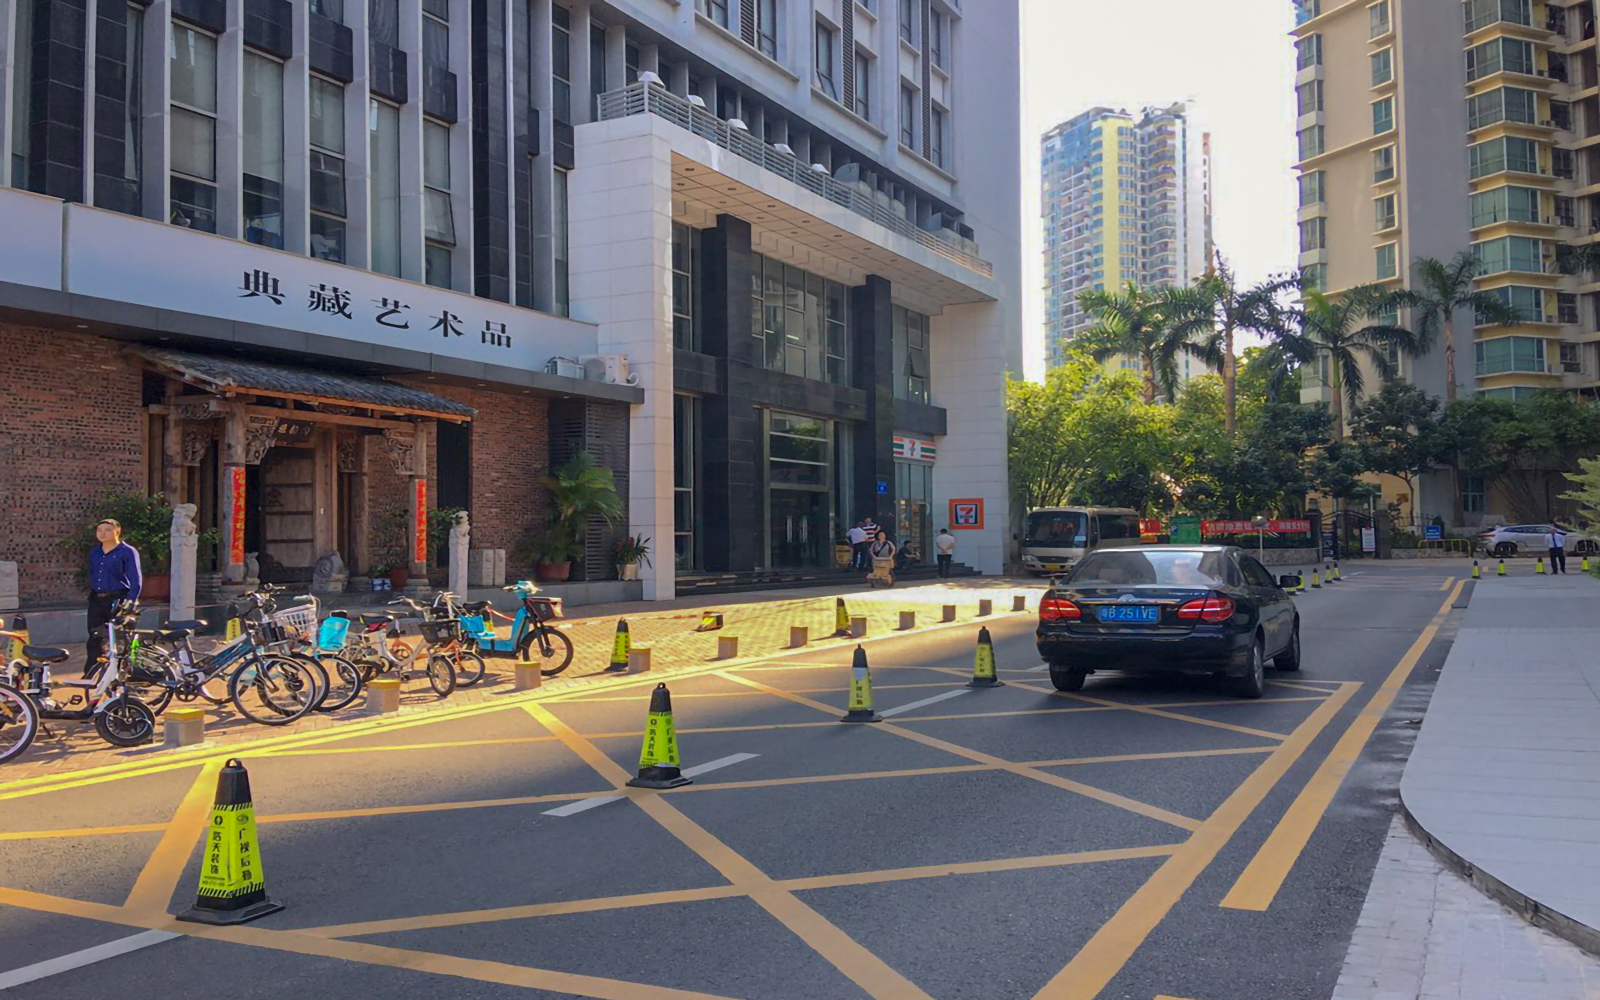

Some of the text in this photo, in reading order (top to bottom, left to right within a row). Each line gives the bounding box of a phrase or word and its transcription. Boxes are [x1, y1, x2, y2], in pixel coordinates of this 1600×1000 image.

[238, 269, 512, 348] 典藏艺术品
